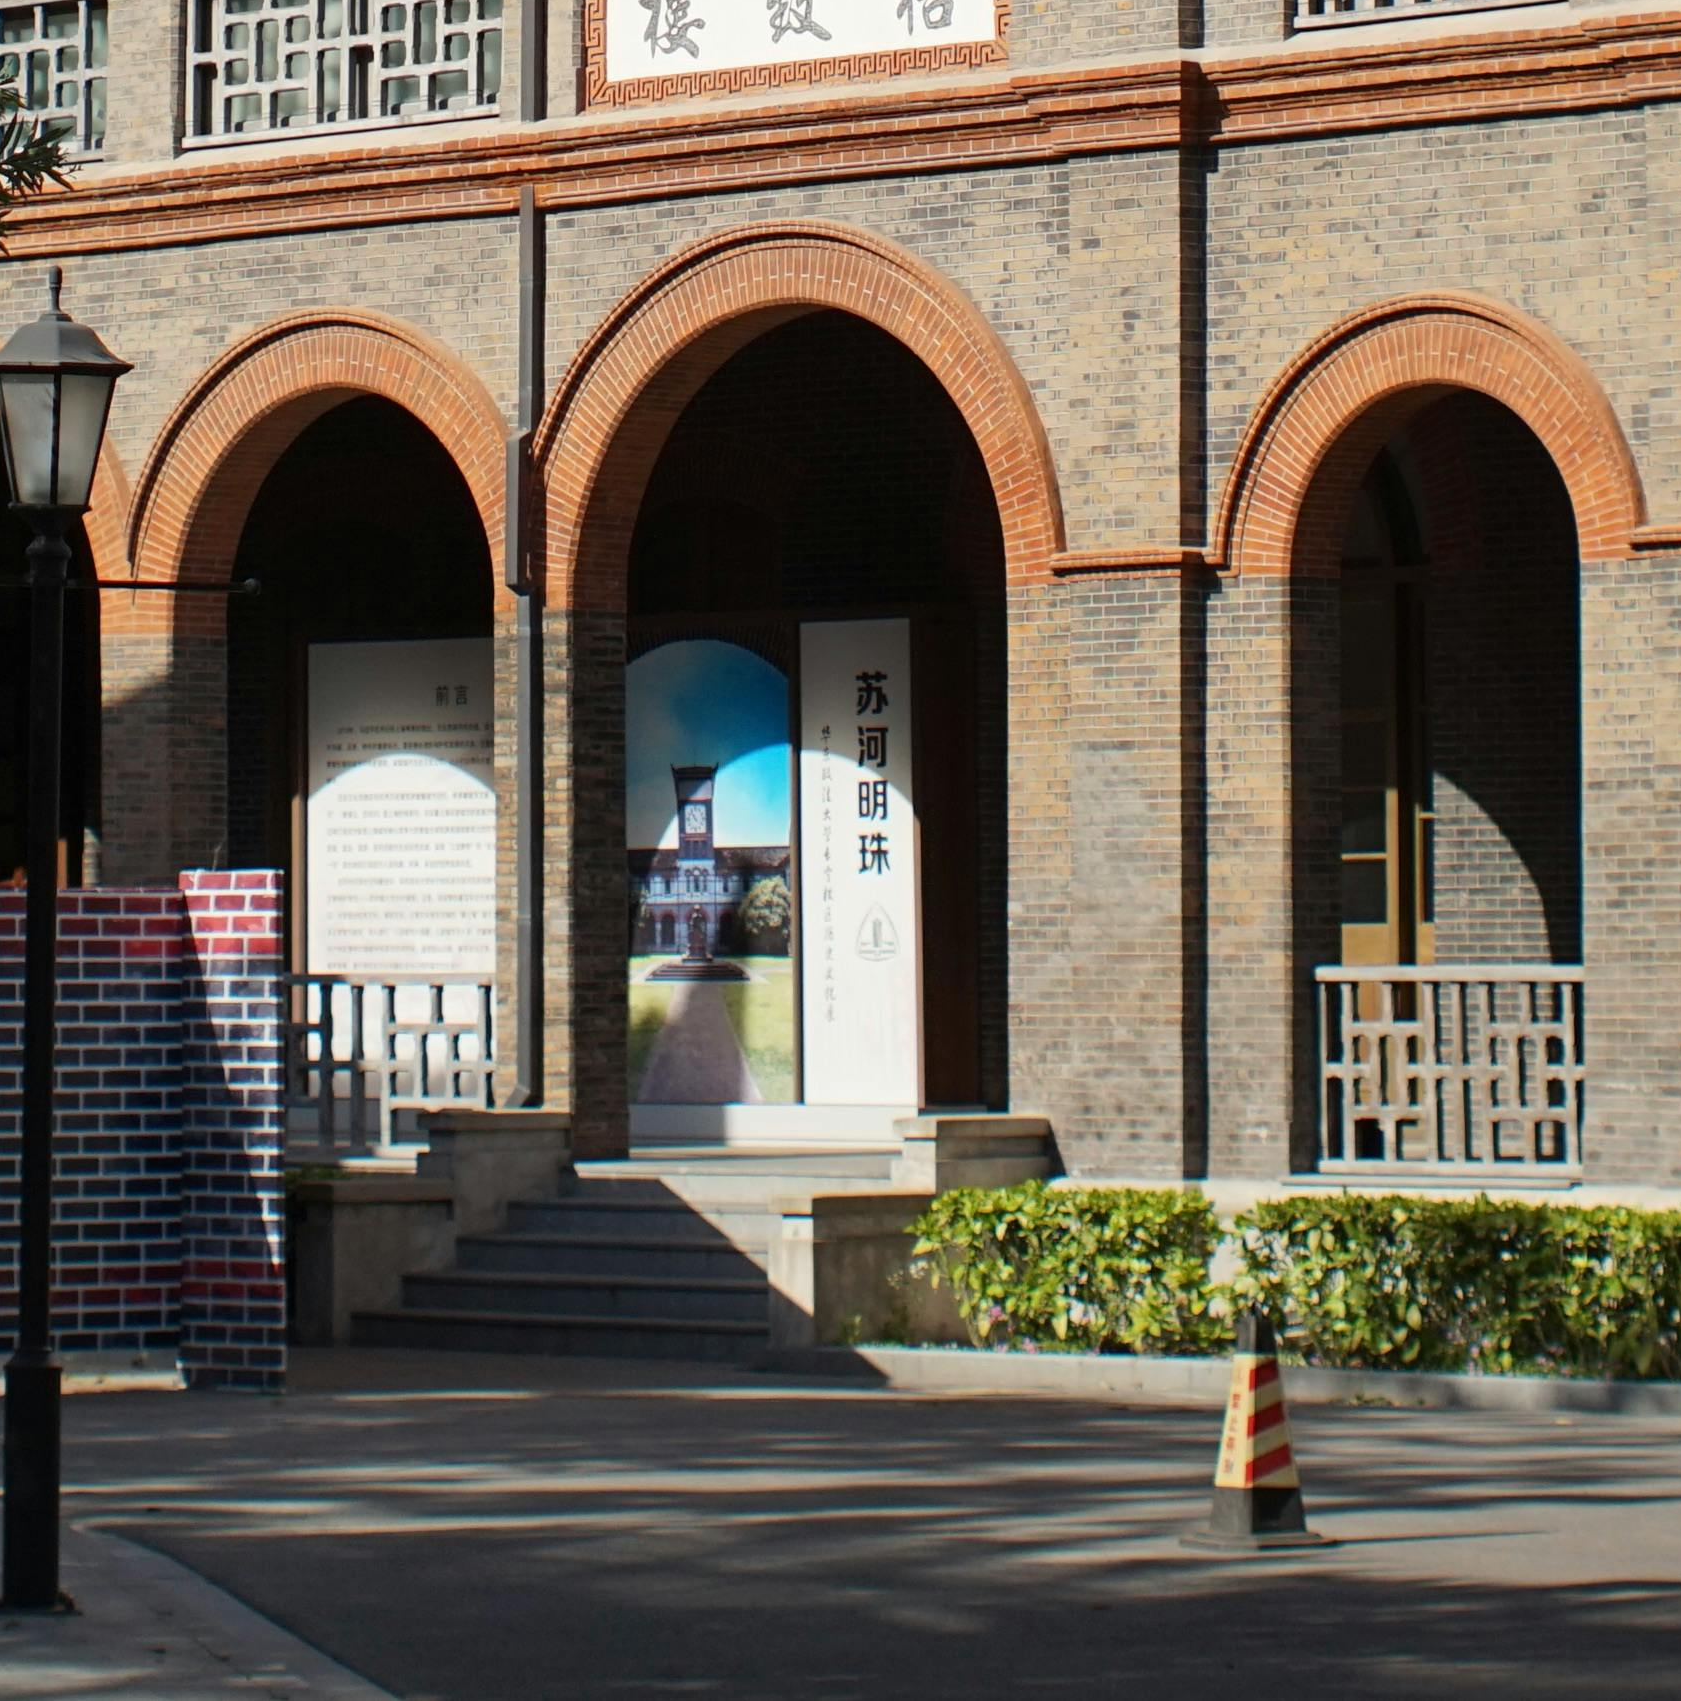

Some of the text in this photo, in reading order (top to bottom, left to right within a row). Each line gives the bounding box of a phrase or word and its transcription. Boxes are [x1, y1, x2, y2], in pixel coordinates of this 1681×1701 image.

[435, 684, 469, 707] 前言
[854, 670, 891, 875] 苏河明珠
